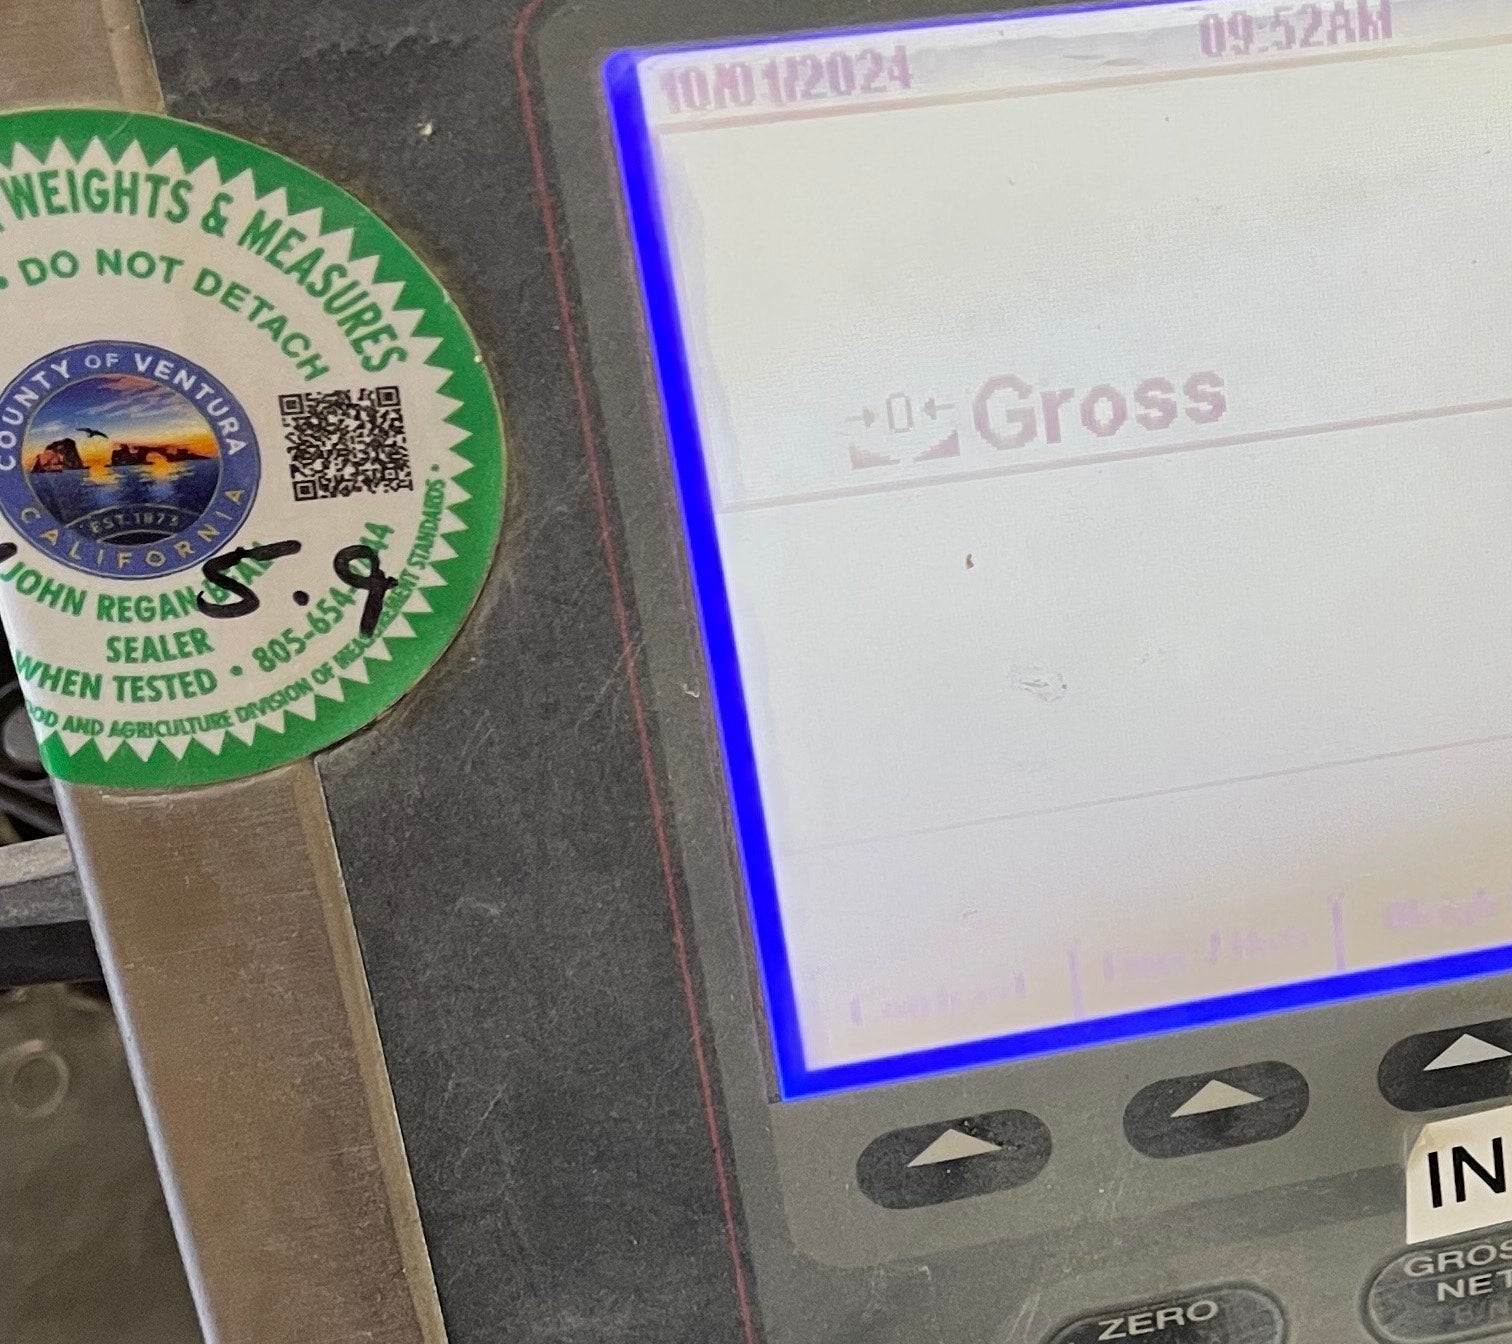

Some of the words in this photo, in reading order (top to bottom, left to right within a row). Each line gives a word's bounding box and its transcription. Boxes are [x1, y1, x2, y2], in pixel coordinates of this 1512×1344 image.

[658, 45, 914, 114] 10/01/2024
[0, 167, 194, 224] WEIGHTS
[201, 191, 236, 237] &
[236, 207, 409, 374] MEASURES
[18, 249, 80, 287] DO
[95, 248, 186, 285] NOT
[192, 267, 330, 382] DETACH
[0, 359, 71, 471] COUNTY
[84, 353, 120, 369] OF
[133, 352, 248, 457] VENTURA
[972, 370, 1228, 452] Gross
[21, 488, 246, 570] CALIFORNIA
[1, 560, 88, 618] JOHN
[96, 584, 201, 624] REGAN
[61, 714, 105, 737] AND
[107, 709, 235, 738] AGRICULTURE
[234, 676, 314, 724] DIVISION
[311, 660, 336, 686] OF
[407, 478, 446, 571] STANDARDS
[15, 650, 102, 701] WHEN
[112, 668, 218, 704] TESTED
[106, 626, 216, 665] SEALER
[1426, 1136, 1508, 1209] IN
[1097, 1299, 1219, 1342] ZERO
